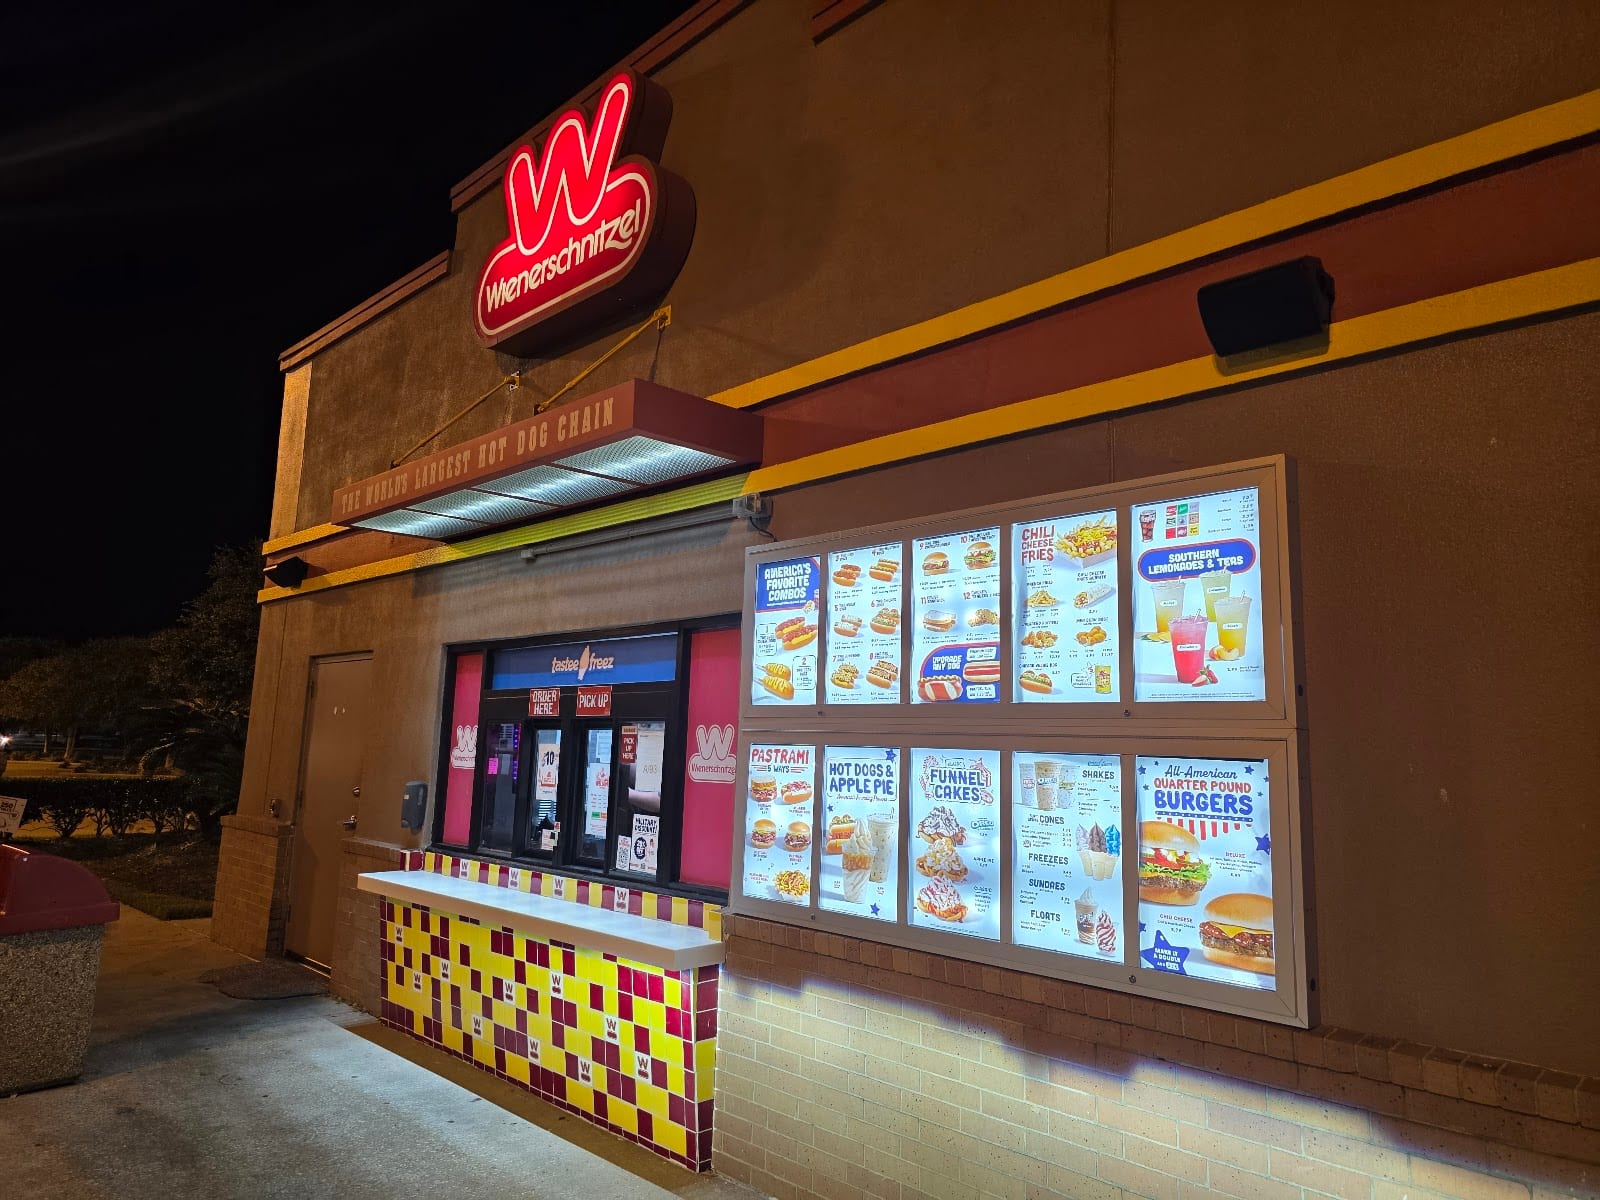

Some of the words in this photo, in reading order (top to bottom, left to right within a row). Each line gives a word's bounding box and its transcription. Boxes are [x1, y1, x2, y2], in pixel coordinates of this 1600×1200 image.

[486, 198, 641, 313] Wienerschnitzel
[342, 490, 360, 514] THE
[366, 472, 408, 506] WORLD'S
[414, 450, 471, 490] LARGEST
[478, 436, 507, 469] HOT
[517, 421, 548, 456] DOG
[557, 397, 614, 442] CHAIN
[1021, 524, 1055, 541] CHILI
[1021, 538, 1054, 550] CHEESE
[1021, 548, 1054, 566] FRIES
[1168, 549, 1220, 563] SOUTHERN
[764, 562, 812, 580] AMERICA'S
[1148, 560, 1204, 575] LEMONADES
[1207, 559, 1214, 568] &
[1217, 555, 1244, 567] TEAS
[766, 575, 810, 591] FAVORITE
[768, 587, 807, 601] COMBOS
[551, 656, 579, 674] tastee
[589, 652, 615, 671] freez
[932, 655, 962, 664] UPGRADE
[932, 663, 945, 671] ANY
[947, 662, 960, 670] DOG
[532, 689, 557, 703] ORDER
[579, 694, 596, 708] PICK
[598, 693, 609, 708] UP
[533, 702, 553, 715] HERE
[623, 737, 635, 745] PICK
[622, 752, 635, 760] HERE
[751, 748, 810, 765] PASTRAMI
[773, 765, 789, 773] WAYS
[829, 763, 852, 776] HOT
[854, 763, 883, 777] DOGS
[885, 765, 893, 777] &
[1082, 769, 1114, 780] SHAKES
[1165, 764, 1237, 779] All-American
[930, 769, 984, 786] FUNNEL
[829, 777, 871, 793] APPLE
[874, 778, 894, 795] PIE
[1154, 777, 1208, 791] QUARTER
[1210, 780, 1252, 794] POUND
[934, 785, 980, 801] CAKES
[1154, 789, 1253, 815] BURGERS
[1039, 815, 1064, 825] CONES
[1028, 853, 1069, 865] FREEZEES
[462, 862, 469, 871] W
[511, 870, 519, 880] W
[554, 878, 563, 888] W
[1028, 879, 1065, 891] SUNDAES
[617, 890, 627, 901] W
[1030, 909, 1061, 921] FLOATS
[396, 926, 402, 936] W
[441, 962, 449, 972] W
[414, 973, 421, 983] W
[551, 974, 561, 986] W
[505, 982, 513, 993] W
[473, 1015, 481, 1028] W
[606, 1018, 617, 1031] W
[529, 1039, 539, 1051] W
[580, 1061, 590, 1073] W
[637, 1056, 649, 1070] W
